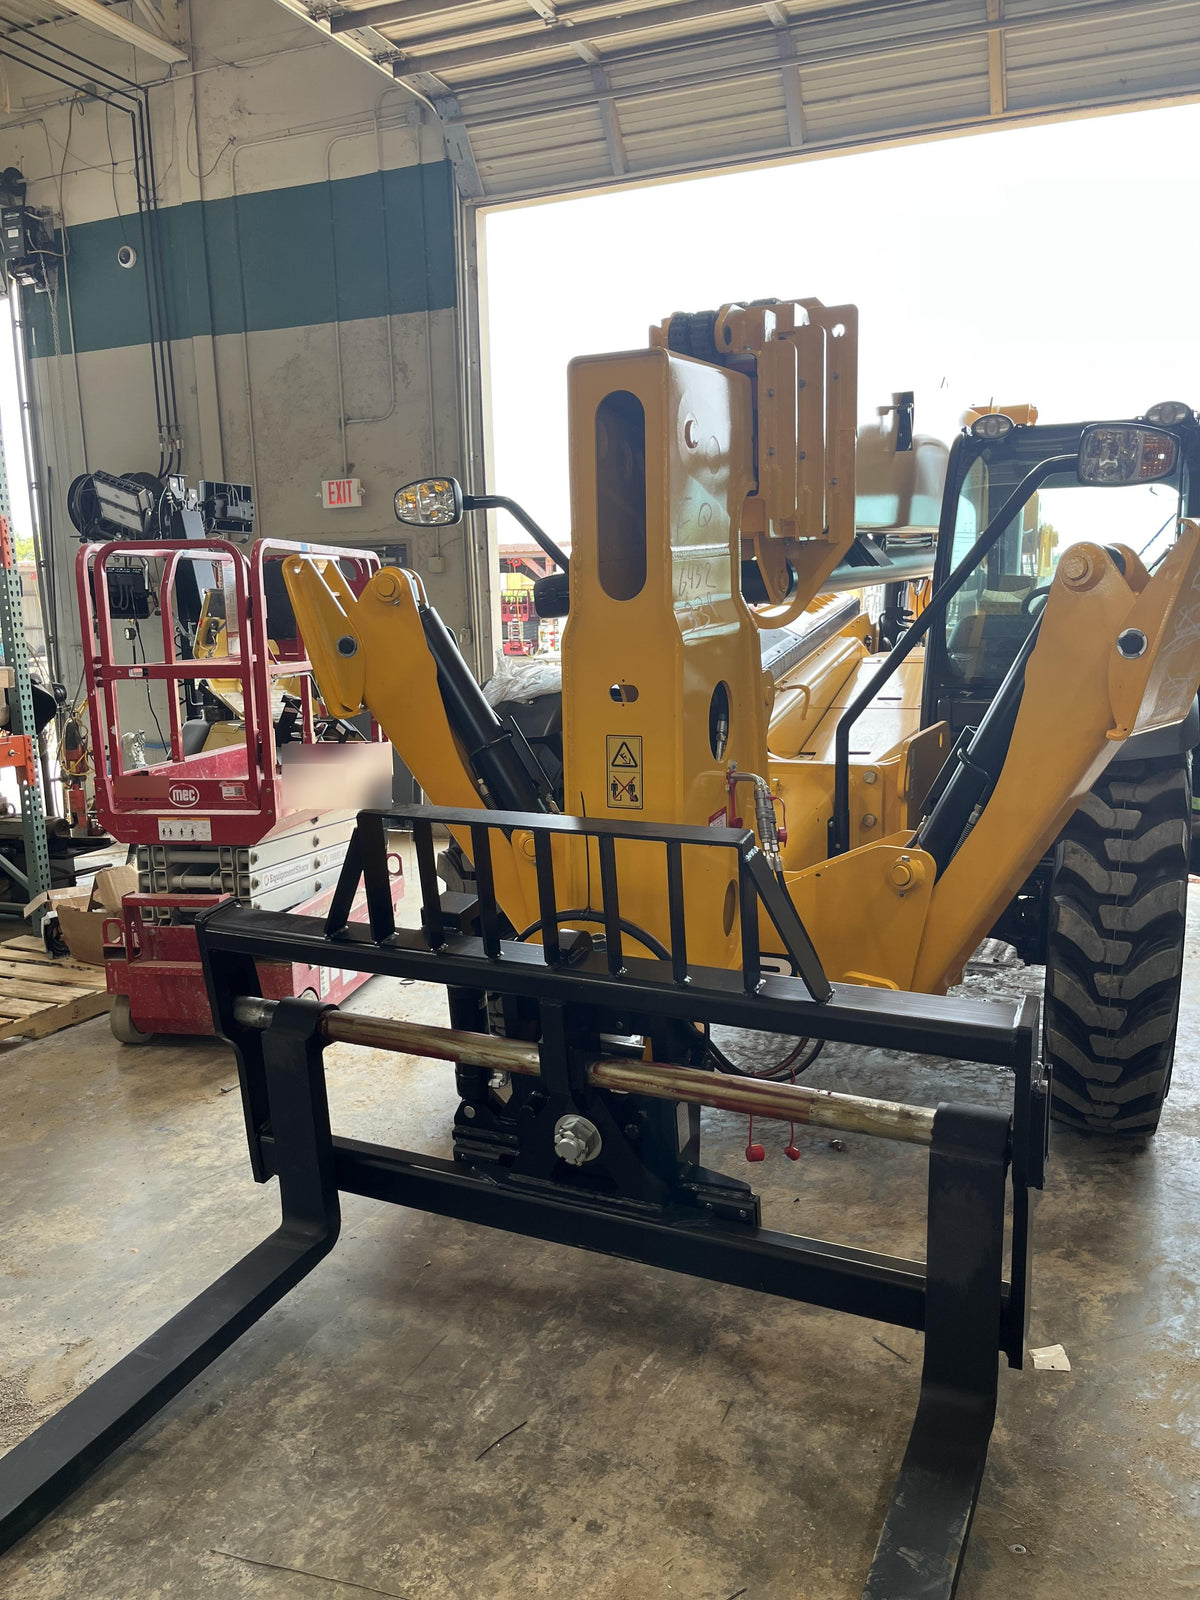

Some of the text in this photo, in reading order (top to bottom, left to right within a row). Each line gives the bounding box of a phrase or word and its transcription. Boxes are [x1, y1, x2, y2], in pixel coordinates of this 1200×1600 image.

[328, 480, 352, 504] EXIT
[172, 789, 196, 801] mec
[269, 864, 309, 883] EquipmentShare
